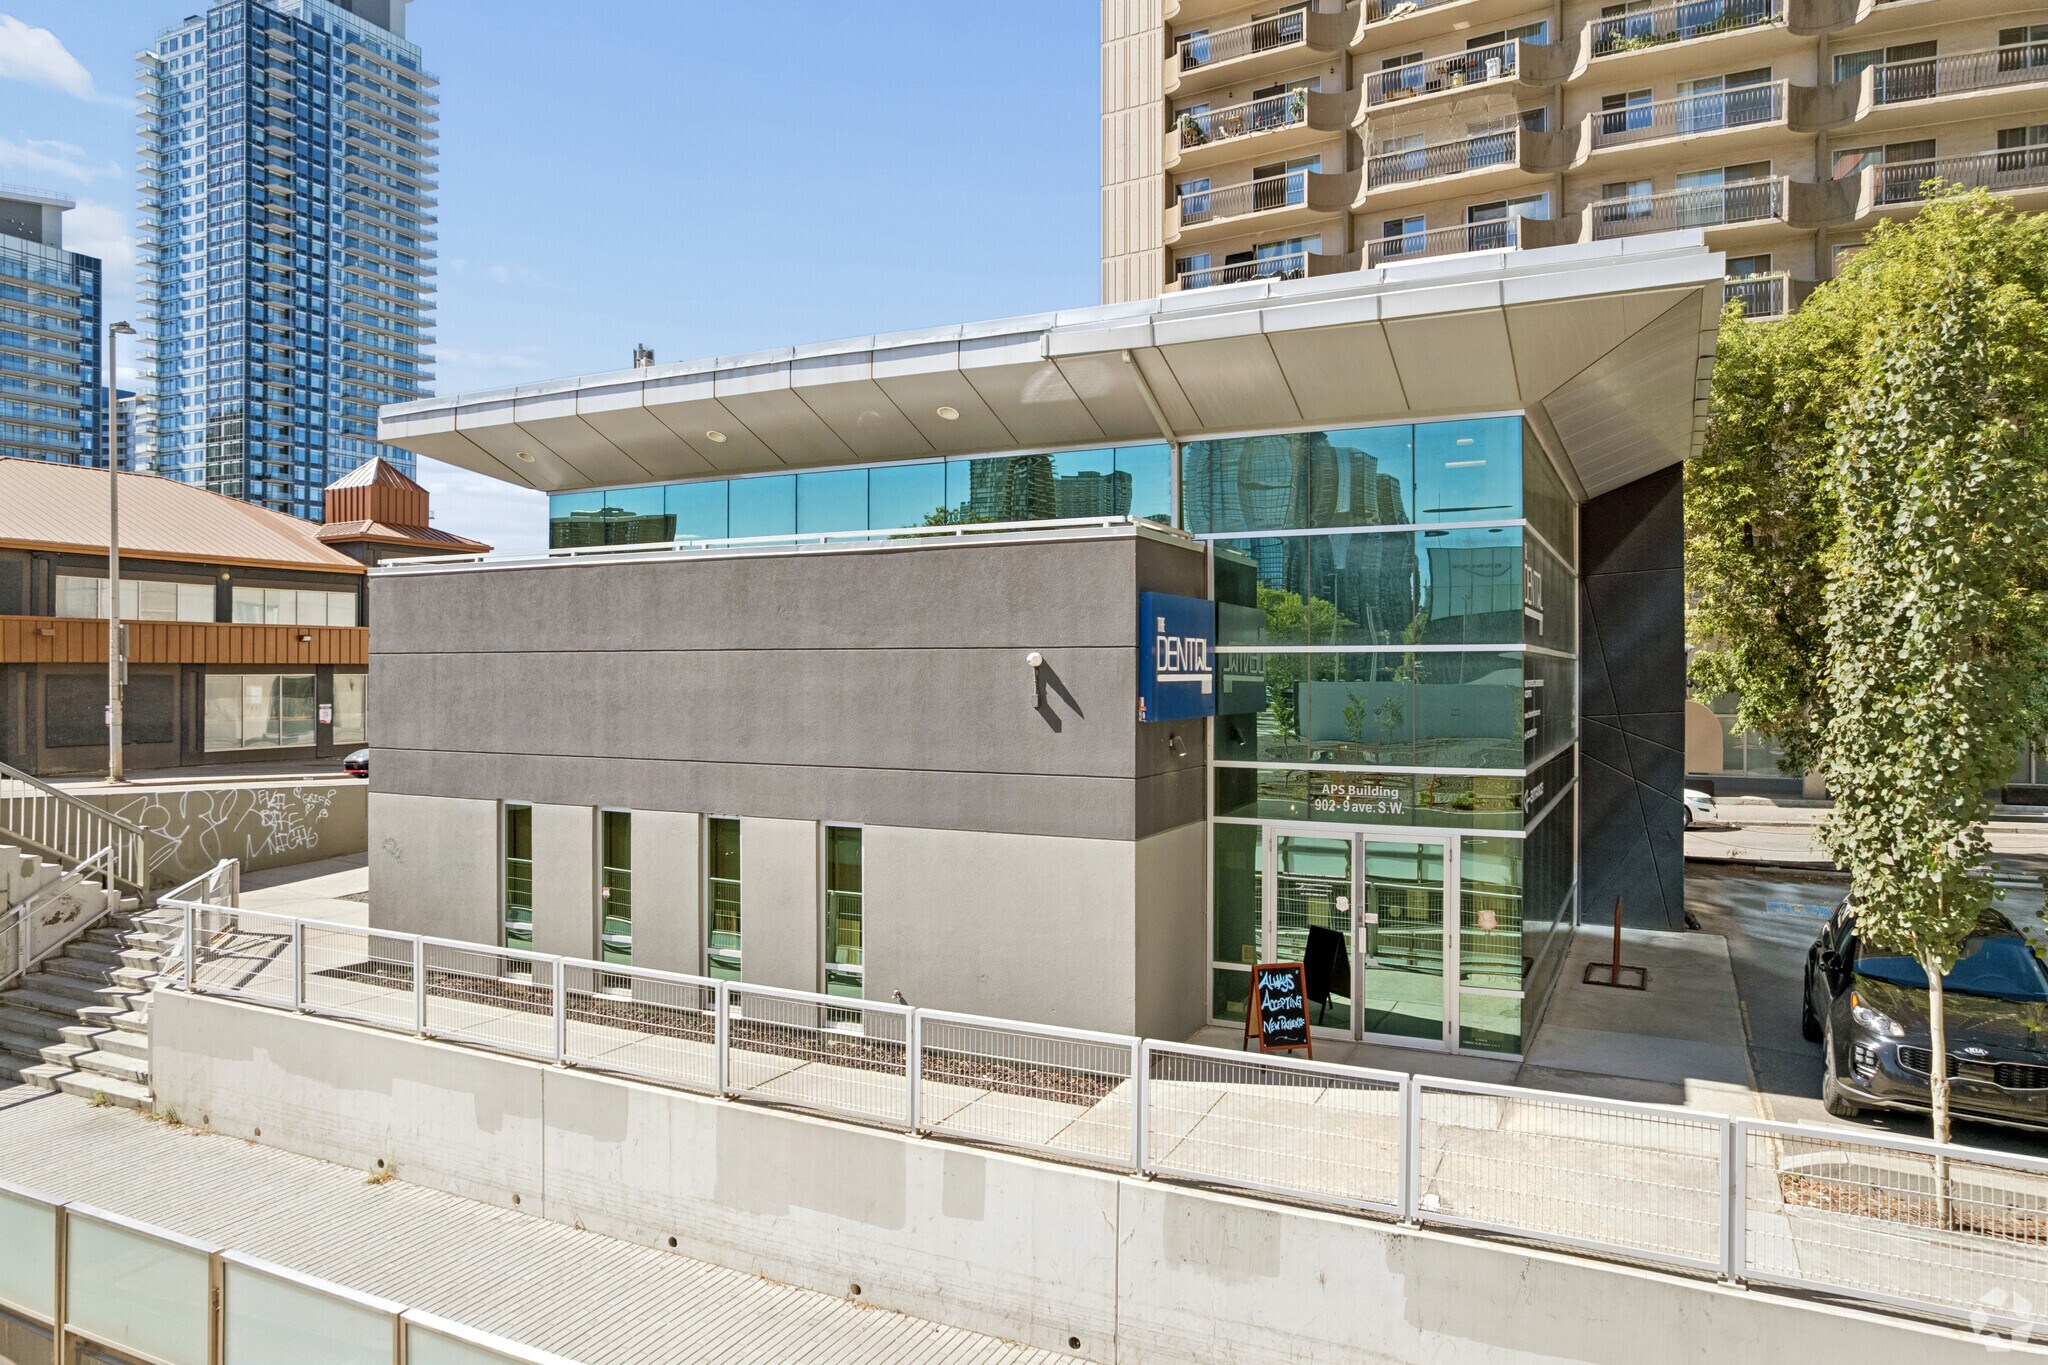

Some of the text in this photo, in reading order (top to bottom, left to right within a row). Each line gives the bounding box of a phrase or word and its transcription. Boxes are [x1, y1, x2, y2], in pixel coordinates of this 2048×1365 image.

[1156, 635, 1213, 672] DENTAL
[1321, 784, 1399, 800] APS Building
[1351, 802, 1376, 814] ave.
[1378, 801, 1405, 815] S.W.
[1263, 1017, 1280, 1034] NEW
